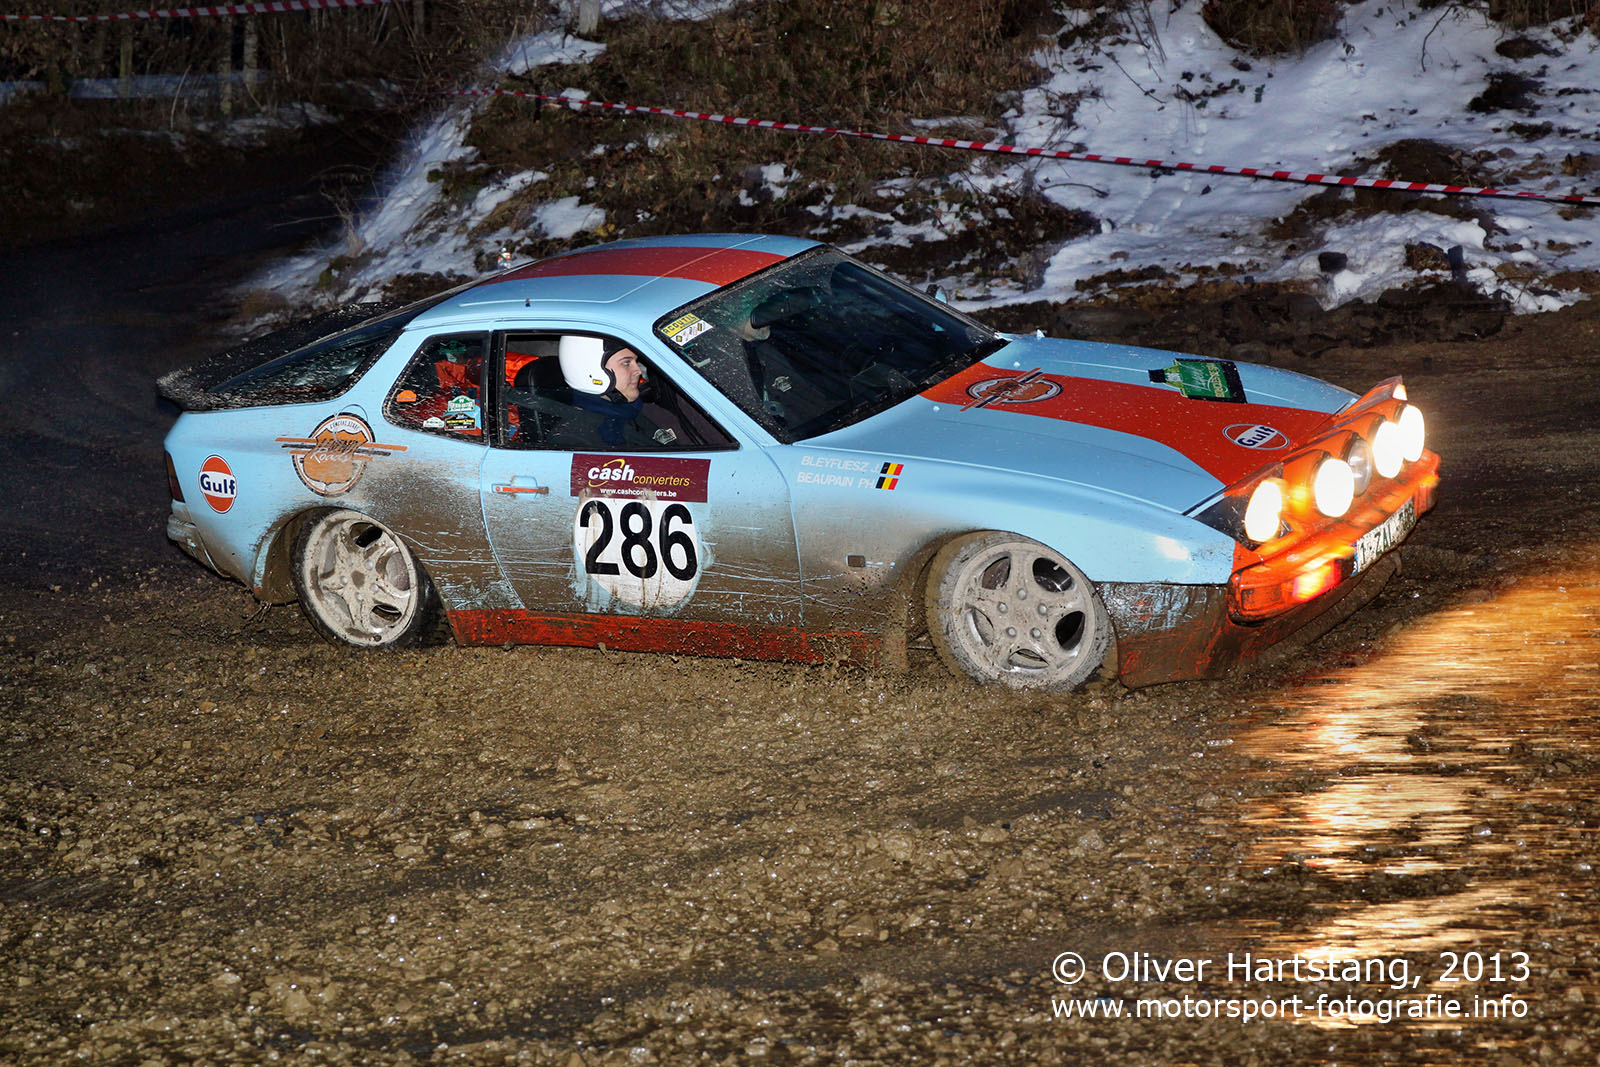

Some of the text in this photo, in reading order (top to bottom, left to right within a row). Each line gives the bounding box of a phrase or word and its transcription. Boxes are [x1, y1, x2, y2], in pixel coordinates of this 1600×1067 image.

[1237, 426, 1276, 446] Gulf
[200, 473, 236, 495] Gulf
[587, 464, 691, 487] cash converters
[797, 471, 854, 488] BEAUPAIN
[600, 488, 677, 498] www.cashconvters.be
[579, 500, 698, 582] 286
